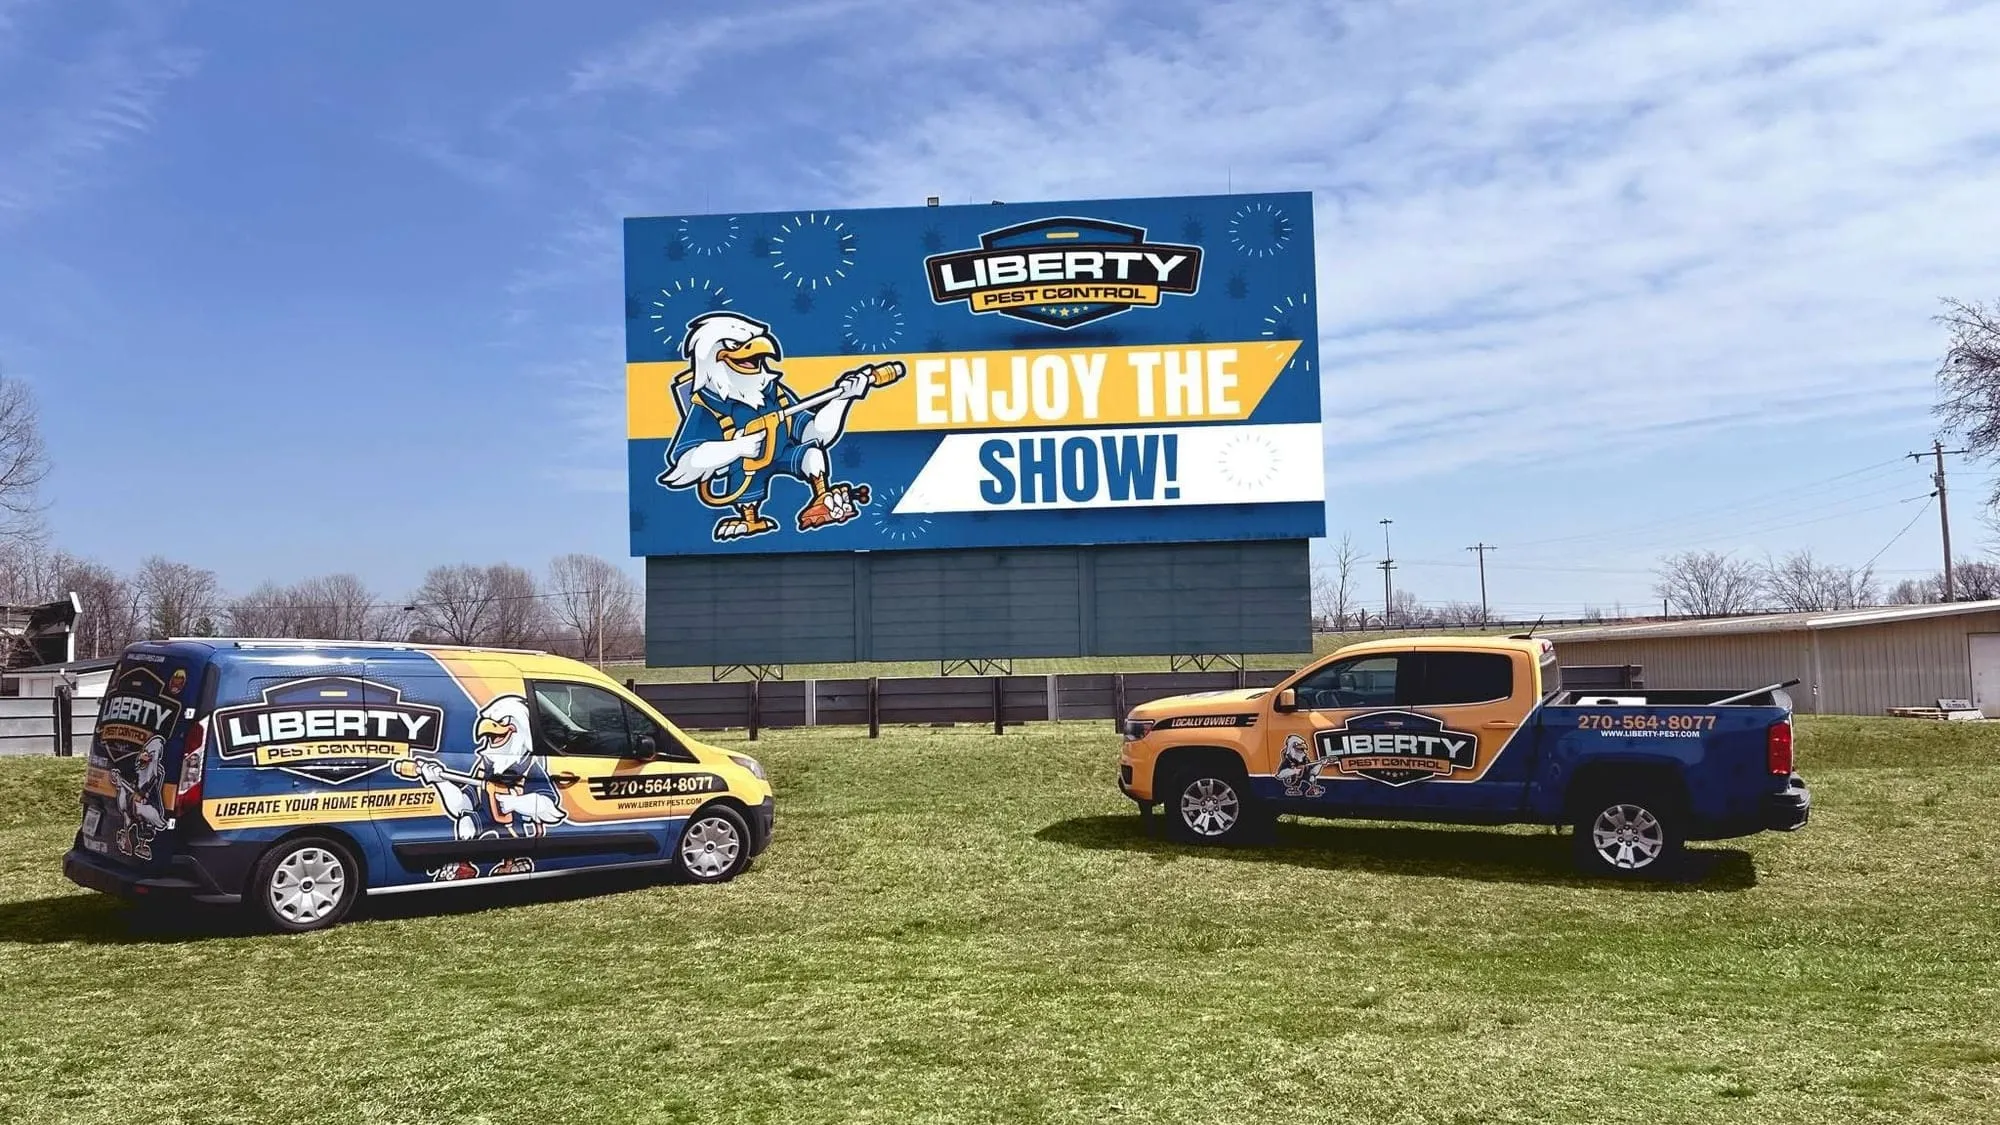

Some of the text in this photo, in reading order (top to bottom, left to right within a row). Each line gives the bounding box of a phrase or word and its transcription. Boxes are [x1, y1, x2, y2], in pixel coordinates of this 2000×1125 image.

[940, 251, 1187, 292] LIBERTY
[983, 289, 1038, 305] PEST
[915, 349, 1241, 425] ENJOY THE
[978, 433, 1180, 505] SHOW!
[228, 709, 431, 747] LIBERTY
[1171, 716, 1237, 727] LOCALLY OWNED
[1323, 734, 1467, 758] LIBERTY
[1600, 730, 1700, 738] WWW.LIBERTY-PEST.COM
[267, 744, 315, 760] PEST
[1348, 759, 1379, 767] PEST
[215, 792, 436, 817] LIBERATE YOUR HOME FROM PESTS
